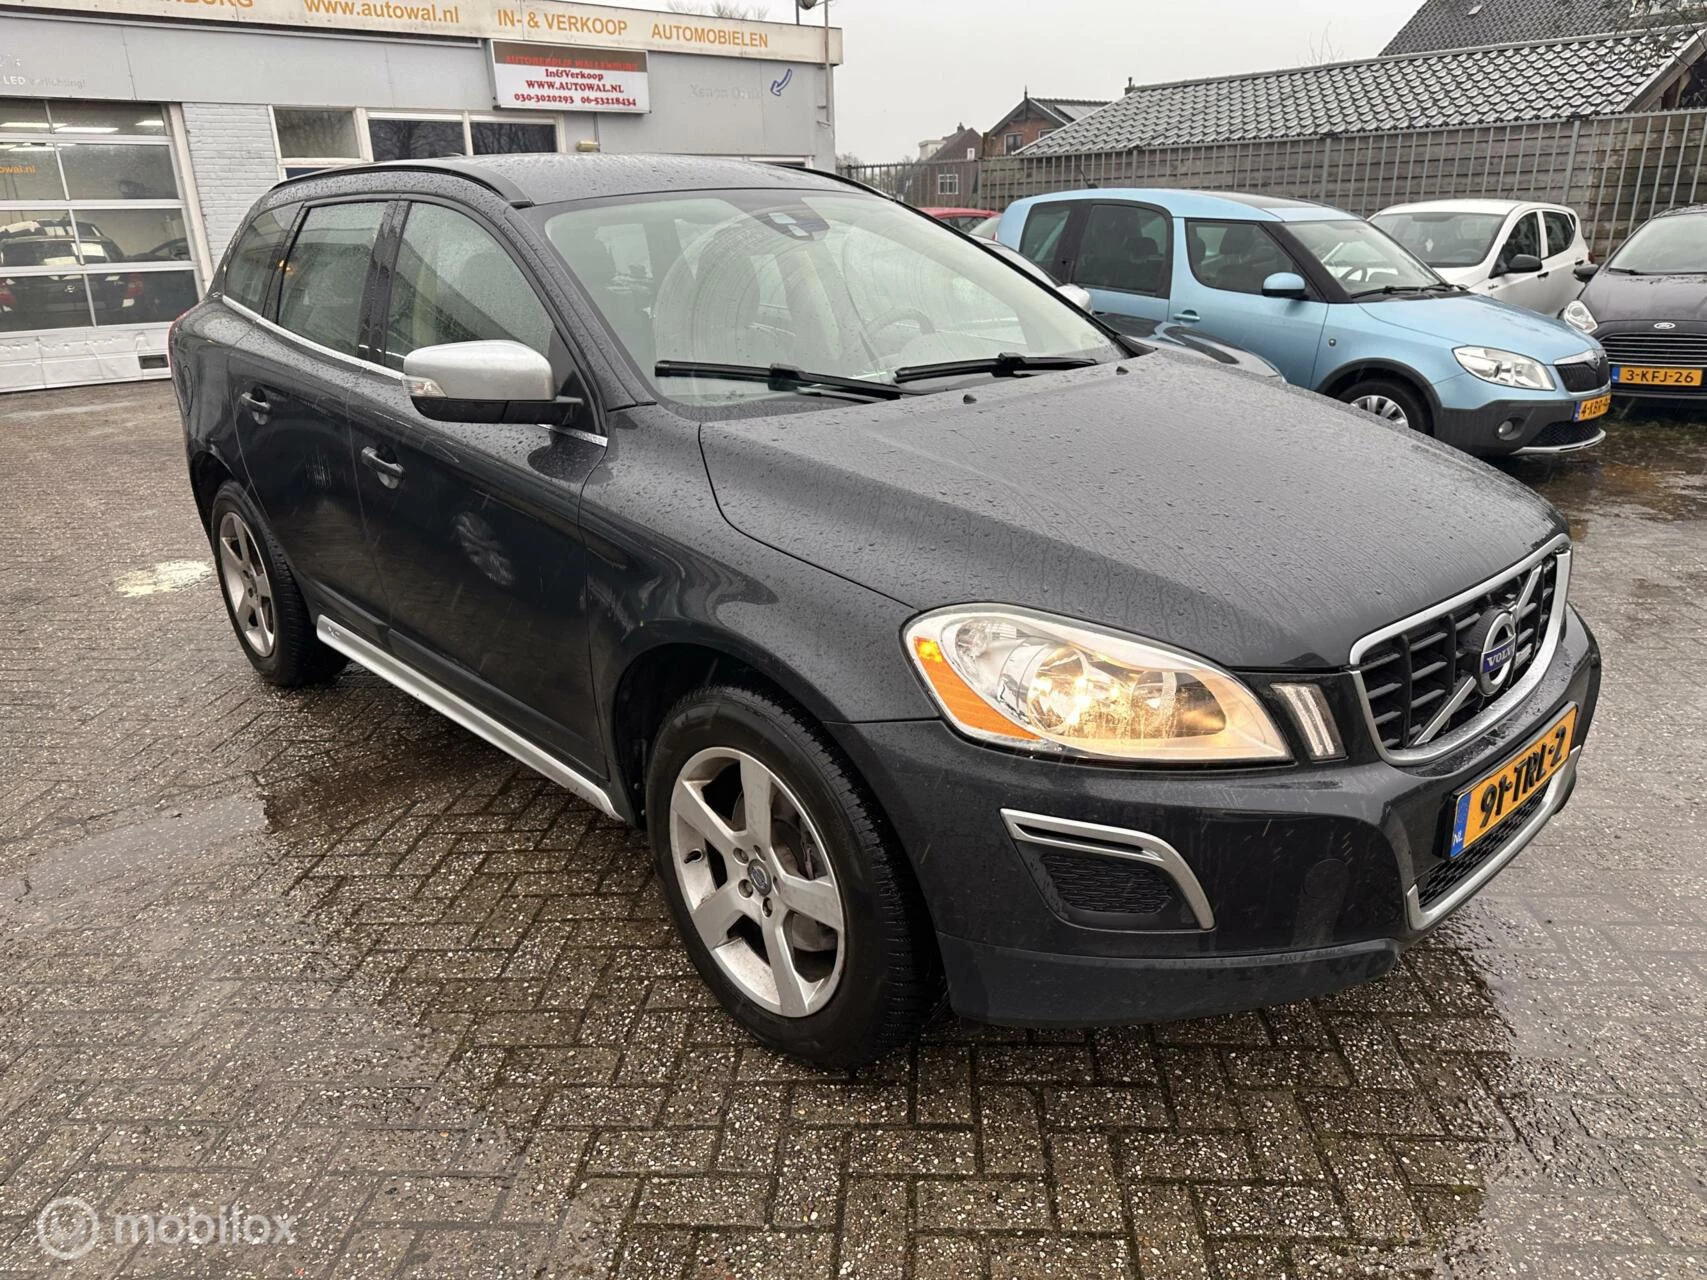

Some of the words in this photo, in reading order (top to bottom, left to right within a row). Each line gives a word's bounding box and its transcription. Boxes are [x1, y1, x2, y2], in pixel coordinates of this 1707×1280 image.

[305, 0, 459, 23] www.autowal.nl
[497, 9, 523, 27] IN-
[527, 11, 540, 29] &
[544, 13, 628, 36] VERKOOP
[651, 23, 768, 48] AUTOMOBIELEN
[3, 74, 26, 86] LED
[545, 68, 604, 81] In&Verkoop
[526, 80, 624, 94] WWW.AUTOWAL.NL
[514, 93, 575, 104] 030-3020293
[581, 96, 637, 106] 06-53218434
[1626, 369, 1694, 384] 3-KFJ-26
